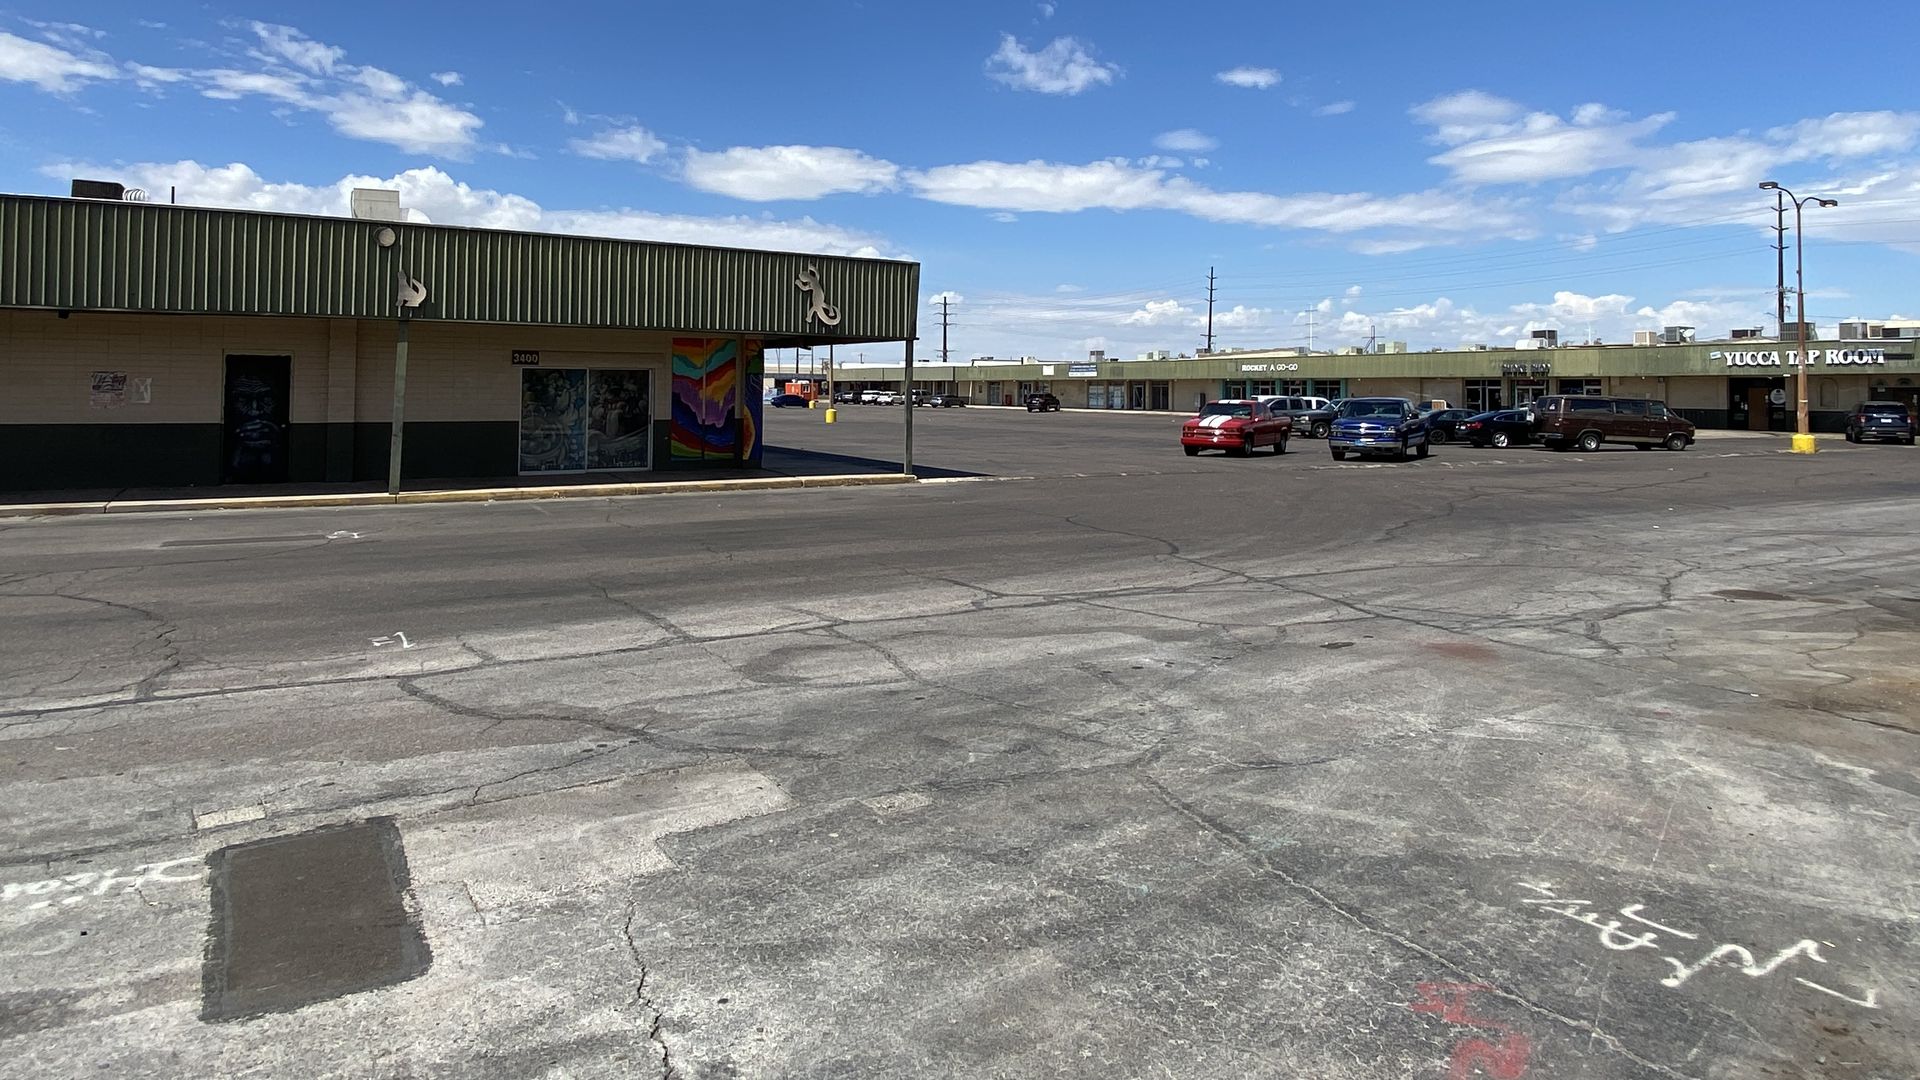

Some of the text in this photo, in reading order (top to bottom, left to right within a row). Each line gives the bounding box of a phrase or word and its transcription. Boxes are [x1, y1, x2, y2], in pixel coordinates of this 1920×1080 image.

[513, 353, 538, 363] 3400
[1723, 351, 1781, 366] YUCCA
[1825, 349, 1885, 365] ROOM
[1241, 364, 1268, 372] ROCKET
